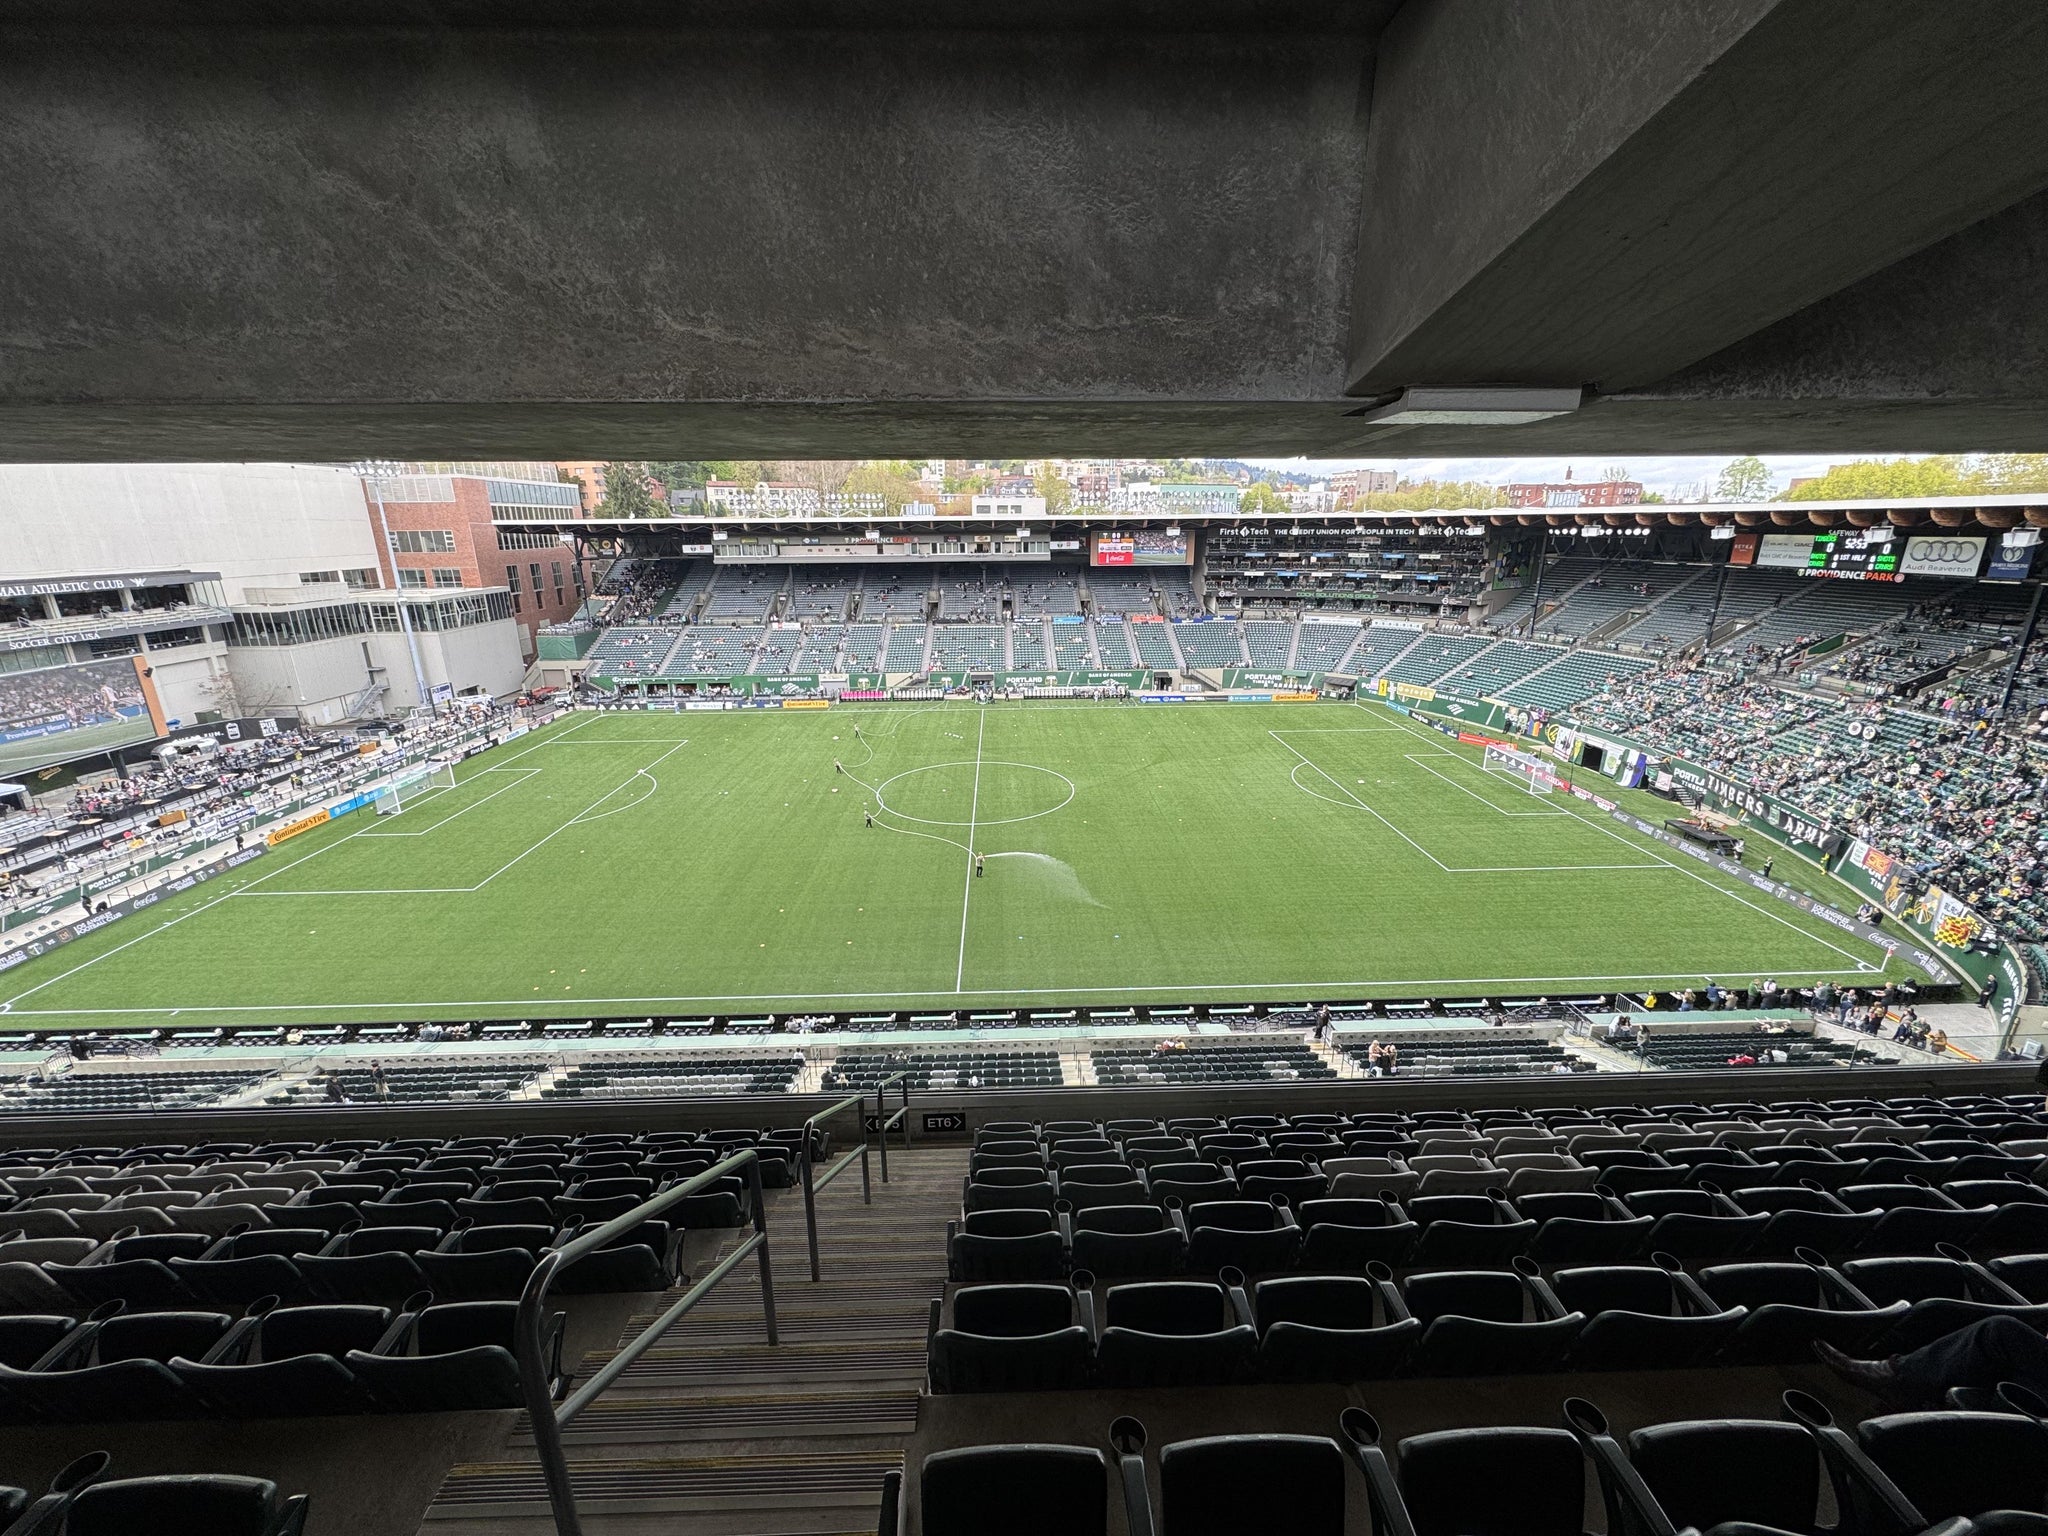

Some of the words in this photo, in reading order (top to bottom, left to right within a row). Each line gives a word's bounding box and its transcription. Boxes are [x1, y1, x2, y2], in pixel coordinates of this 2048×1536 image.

[1826, 543, 1834, 552] 0
[1883, 543, 1891, 554] 0
[1927, 564, 1973, 573] Beaverton
[32, 581, 90, 595] ATHLETIC
[94, 579, 125, 590] CLUB
[10, 636, 52, 650] SOCCER
[55, 635, 77, 645] CITY
[81, 631, 101, 641] USA
[1244, 673, 1283, 681] PORTLAND
[6, 726, 46, 740] Providence
[1708, 774, 1765, 816] TIMBERS
[1783, 816, 1831, 849] ARMY
[274, 821, 310, 842] Continental
[312, 812, 328, 823] Tire
[1718, 861, 1741, 875] Coca-Cola
[88, 871, 128, 890] PORTLAND
[133, 892, 158, 909] Coca-Cola
[1868, 932, 1901, 950] Coca-Cola
[875, 1119, 900, 1129] E5
[927, 1117, 952, 1128] ET6
